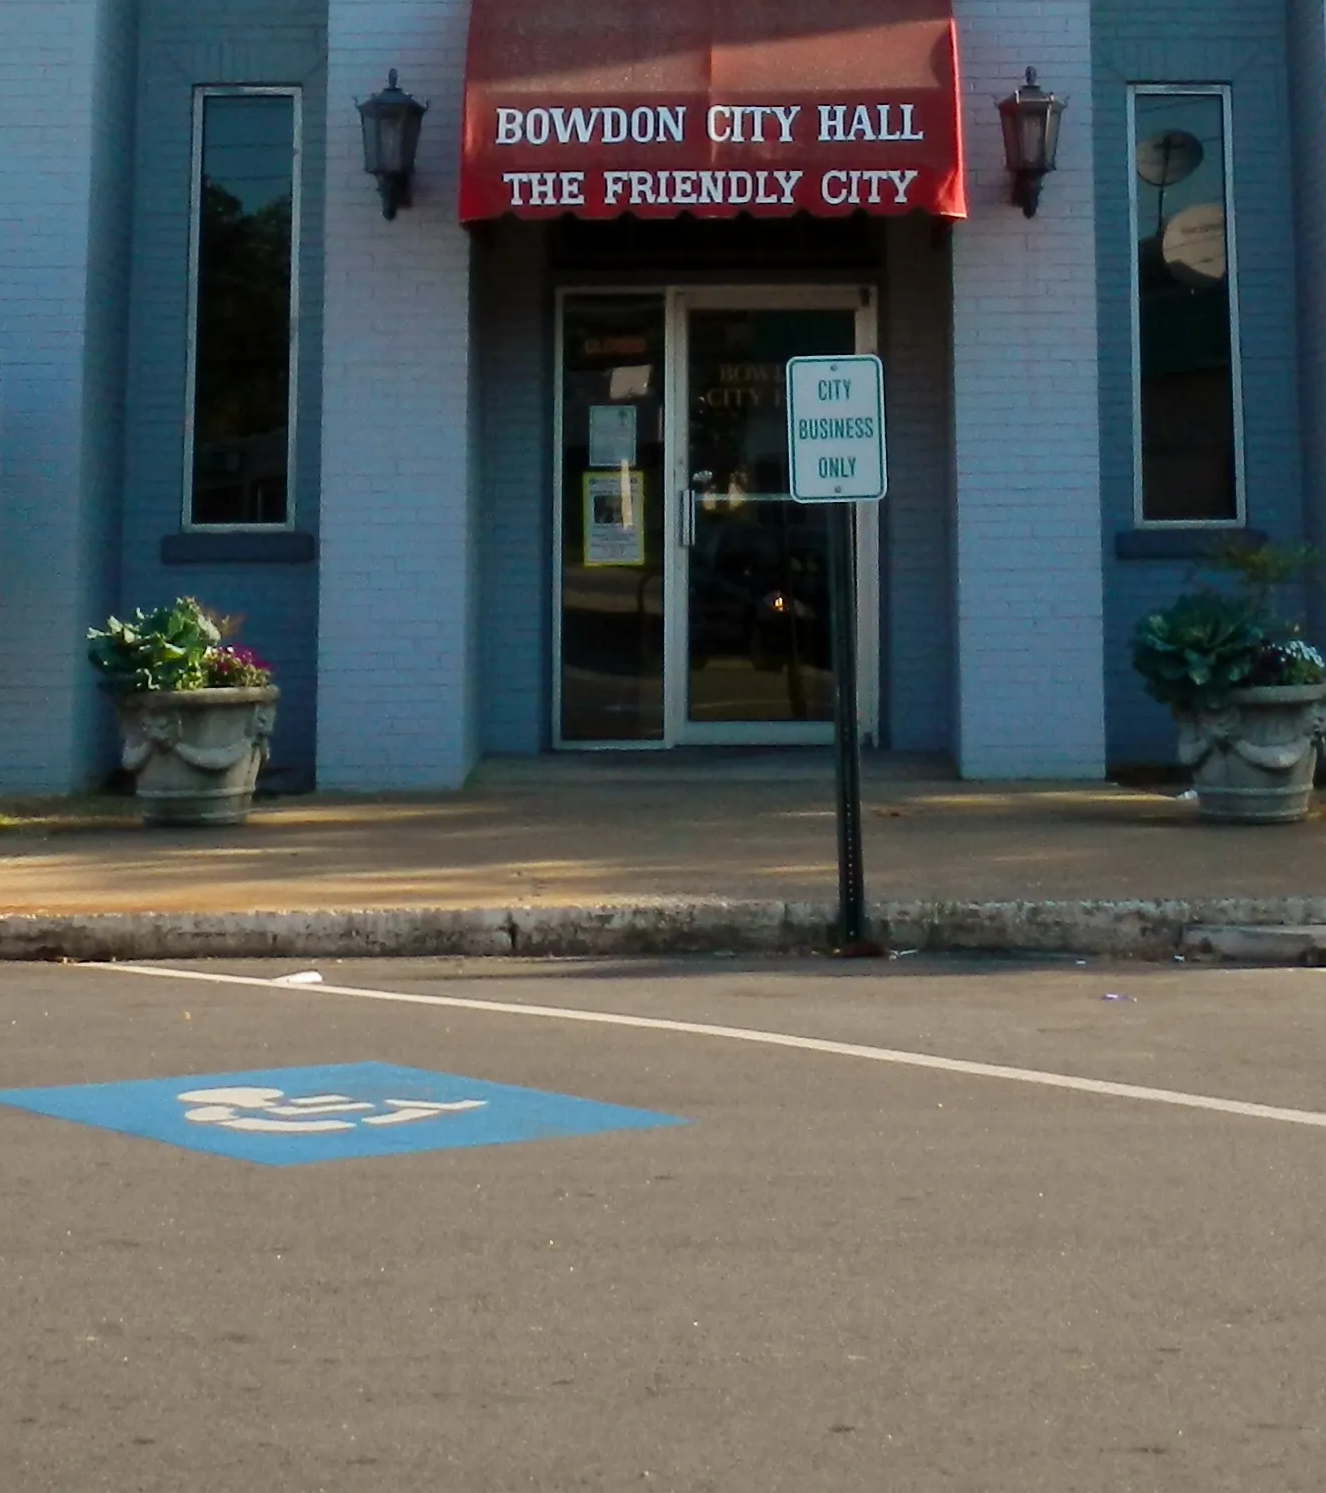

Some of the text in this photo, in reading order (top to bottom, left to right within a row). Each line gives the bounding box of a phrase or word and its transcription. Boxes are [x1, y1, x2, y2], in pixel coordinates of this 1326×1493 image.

[494, 104, 924, 145] BOWDON CITY HALL
[502, 169, 919, 206] THE FRIENDLY CITY
[818, 379, 852, 402] CITY
[798, 417, 875, 440] BUSINESS
[818, 456, 857, 479] ONLY
